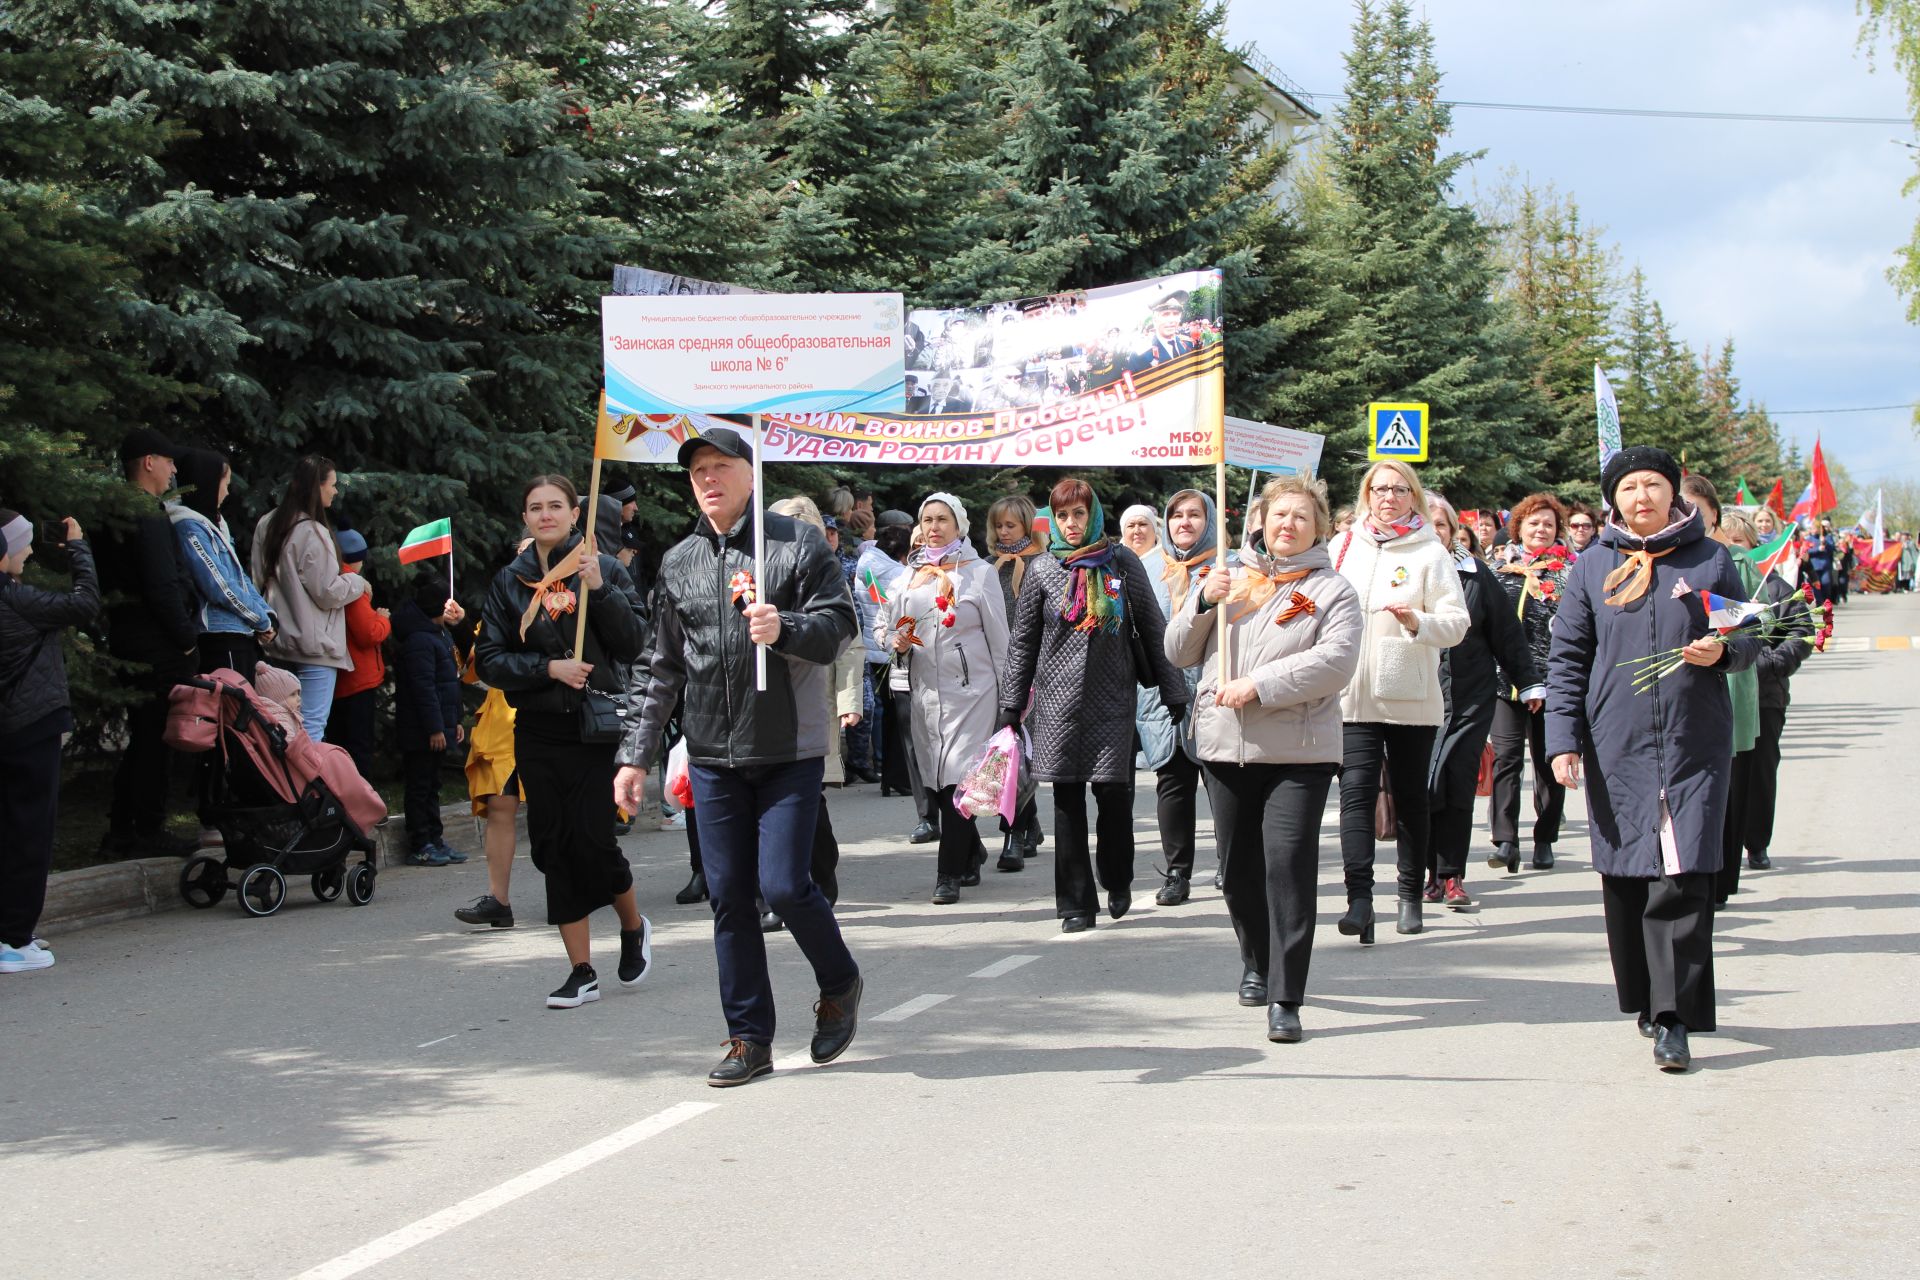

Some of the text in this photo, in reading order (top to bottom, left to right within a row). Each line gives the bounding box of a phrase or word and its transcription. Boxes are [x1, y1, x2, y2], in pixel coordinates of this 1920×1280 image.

[641, 315, 696, 323] Муниципальное
[739, 313, 816, 322] общеобразовательное
[819, 313, 861, 322] учреждение
[679, 338, 733, 353] средняя
[737, 334, 891, 352] общеобразовательная
[710, 360, 752, 372] школа
[756, 357, 772, 371] №
[693, 382, 813, 391] Заинского муниципального района
[864, 419, 985, 440] воинов
[994, 370, 1138, 435] Победы!
[763, 403, 1147, 463] Будем Родину беречь!
[1169, 431, 1213, 443] МБОУ
